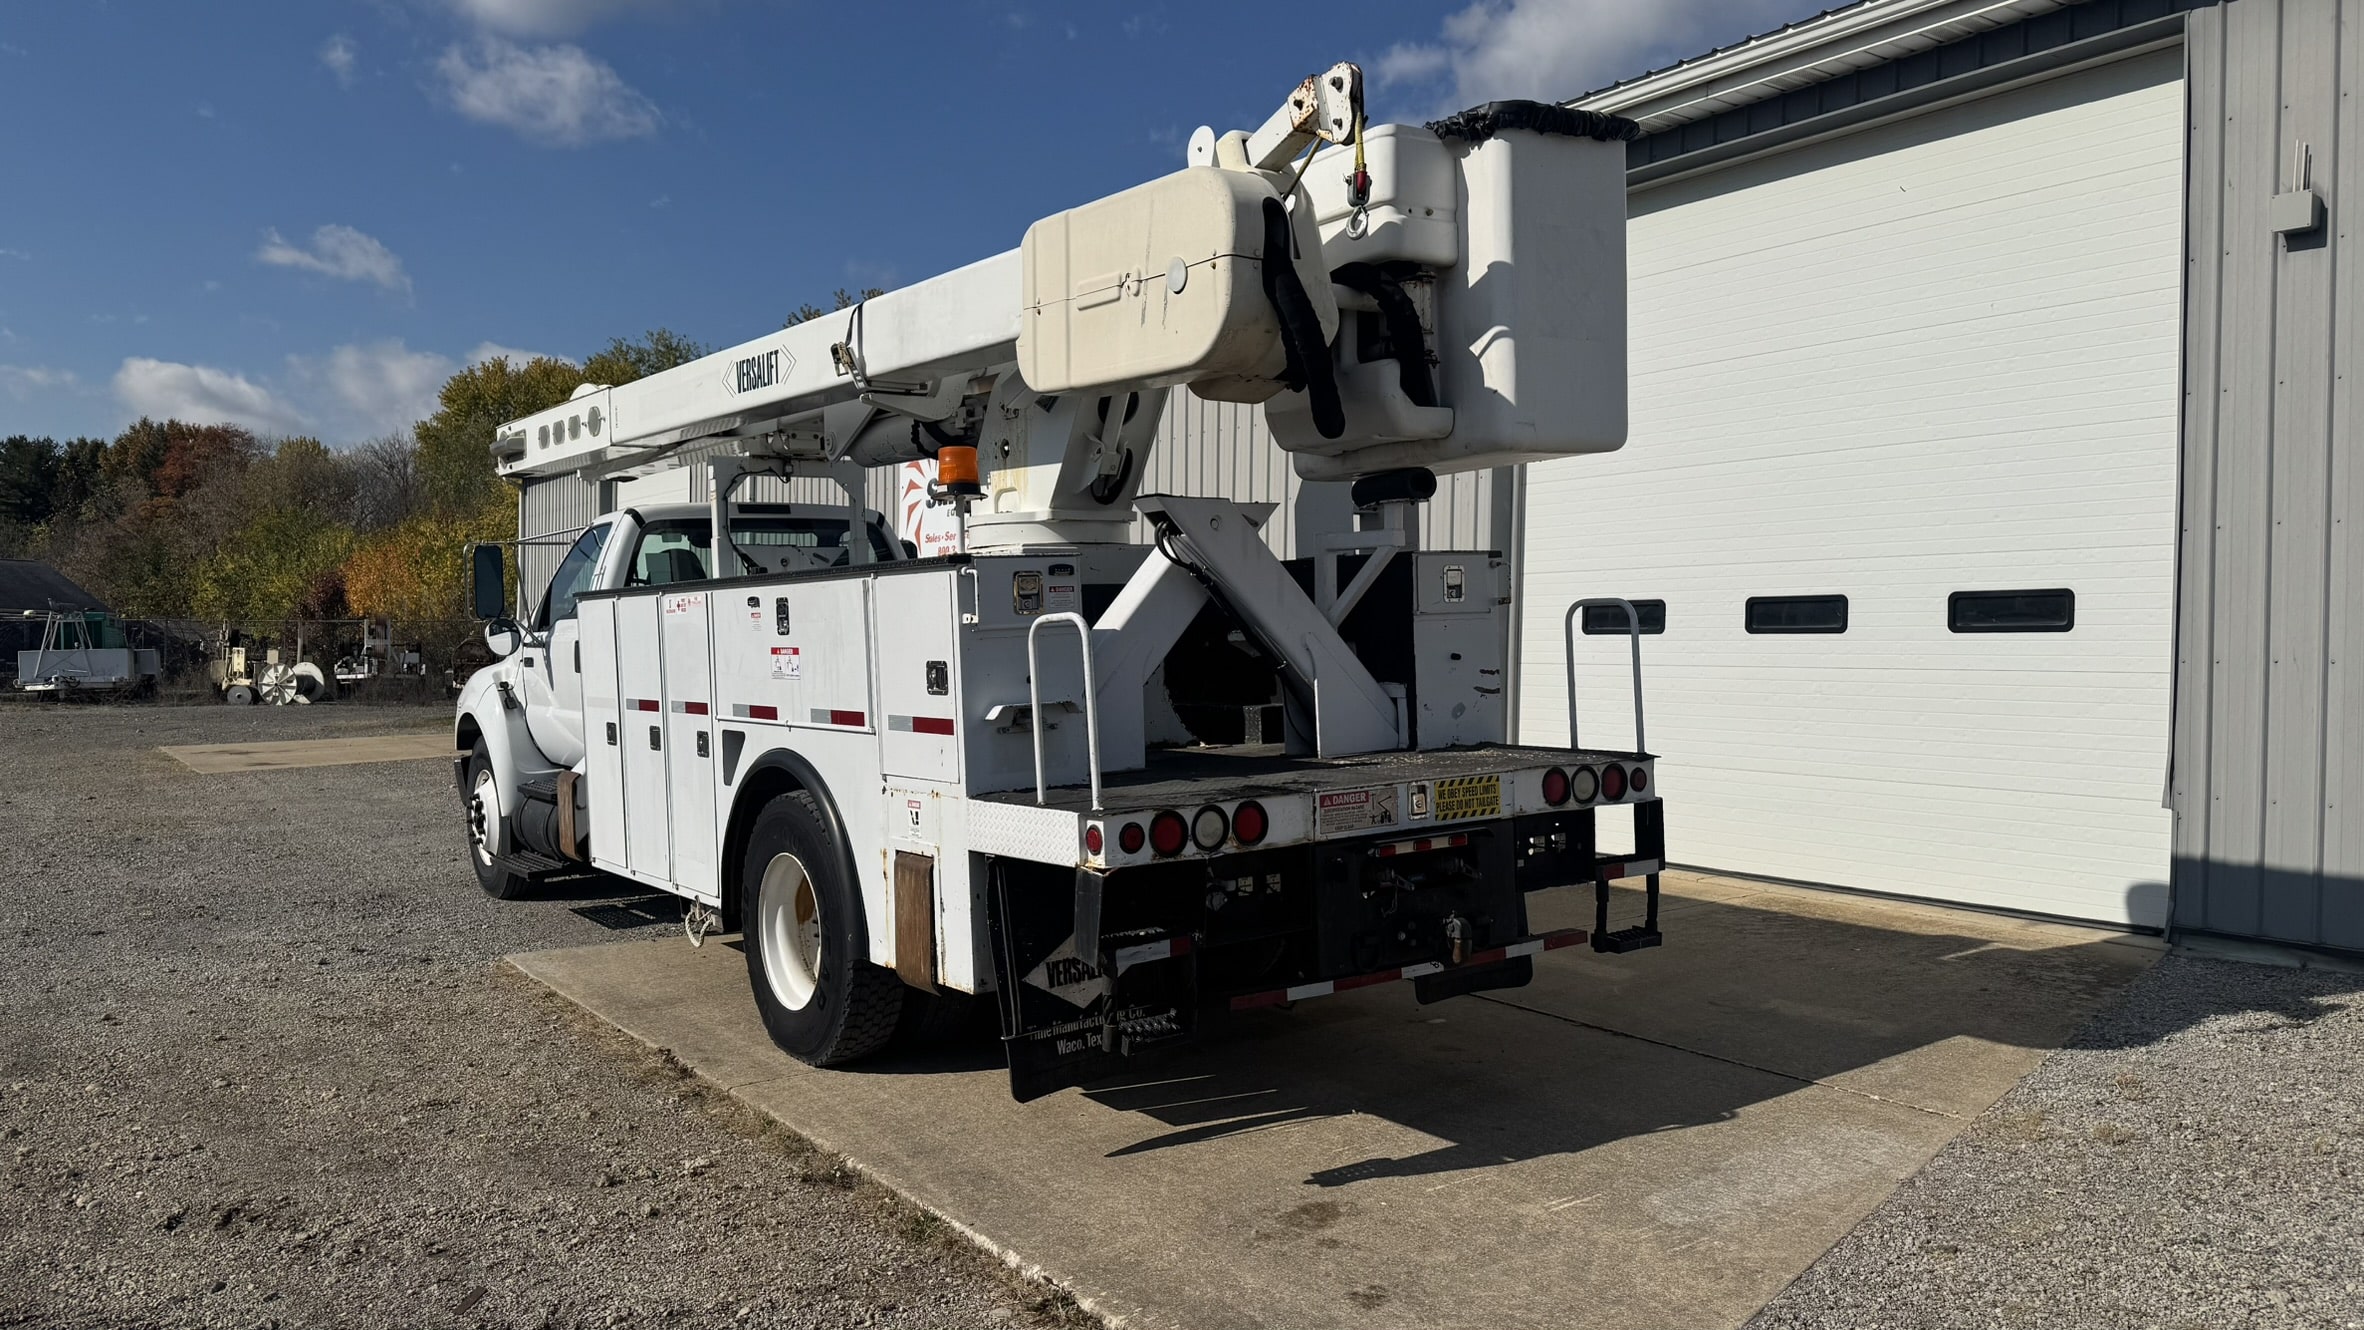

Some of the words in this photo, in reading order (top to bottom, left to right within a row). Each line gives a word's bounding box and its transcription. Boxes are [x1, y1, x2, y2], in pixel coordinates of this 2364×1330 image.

[736, 349, 779, 394] VERSALIFT
[1332, 792, 1366, 805] DANGER
[1438, 789, 1446, 800] WE
[1447, 788, 1461, 799] OBEY
[1462, 786, 1478, 798] SPEED
[1479, 783, 1497, 796] LIMITS
[1435, 801, 1455, 813] PLEASE
[1456, 800, 1463, 810] DO
[1464, 798, 1475, 809] NOT
[1475, 795, 1499, 808] TAILGATE
